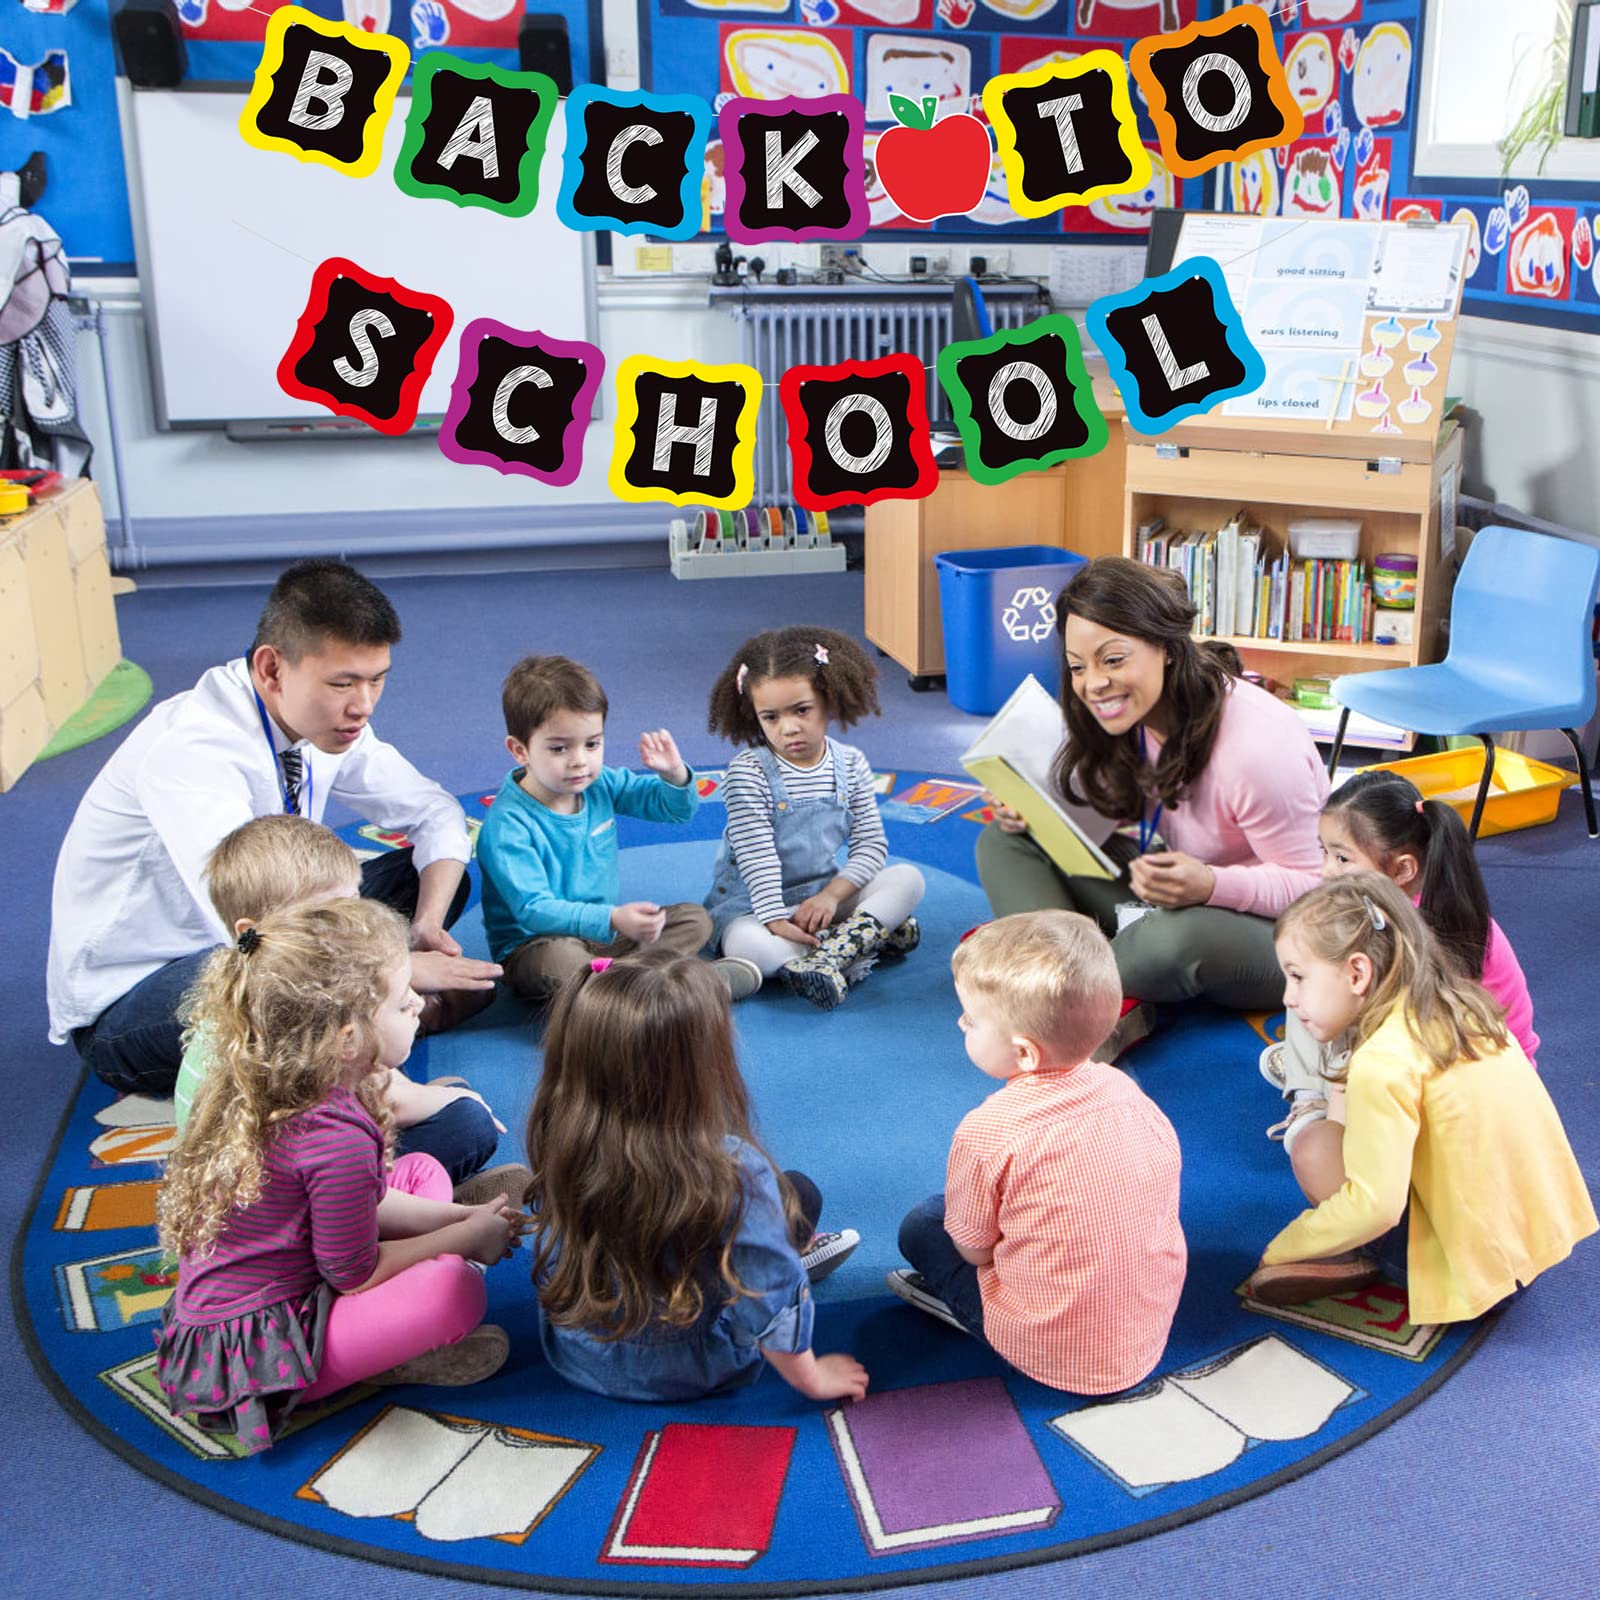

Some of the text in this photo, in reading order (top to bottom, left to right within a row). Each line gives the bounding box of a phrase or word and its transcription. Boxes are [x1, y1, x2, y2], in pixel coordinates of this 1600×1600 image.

[1277, 267, 1345, 279] good sitting
[1260, 327, 1339, 340] ears listening
[1257, 397, 1320, 408] lips closed
[906, 782, 975, 808] W
